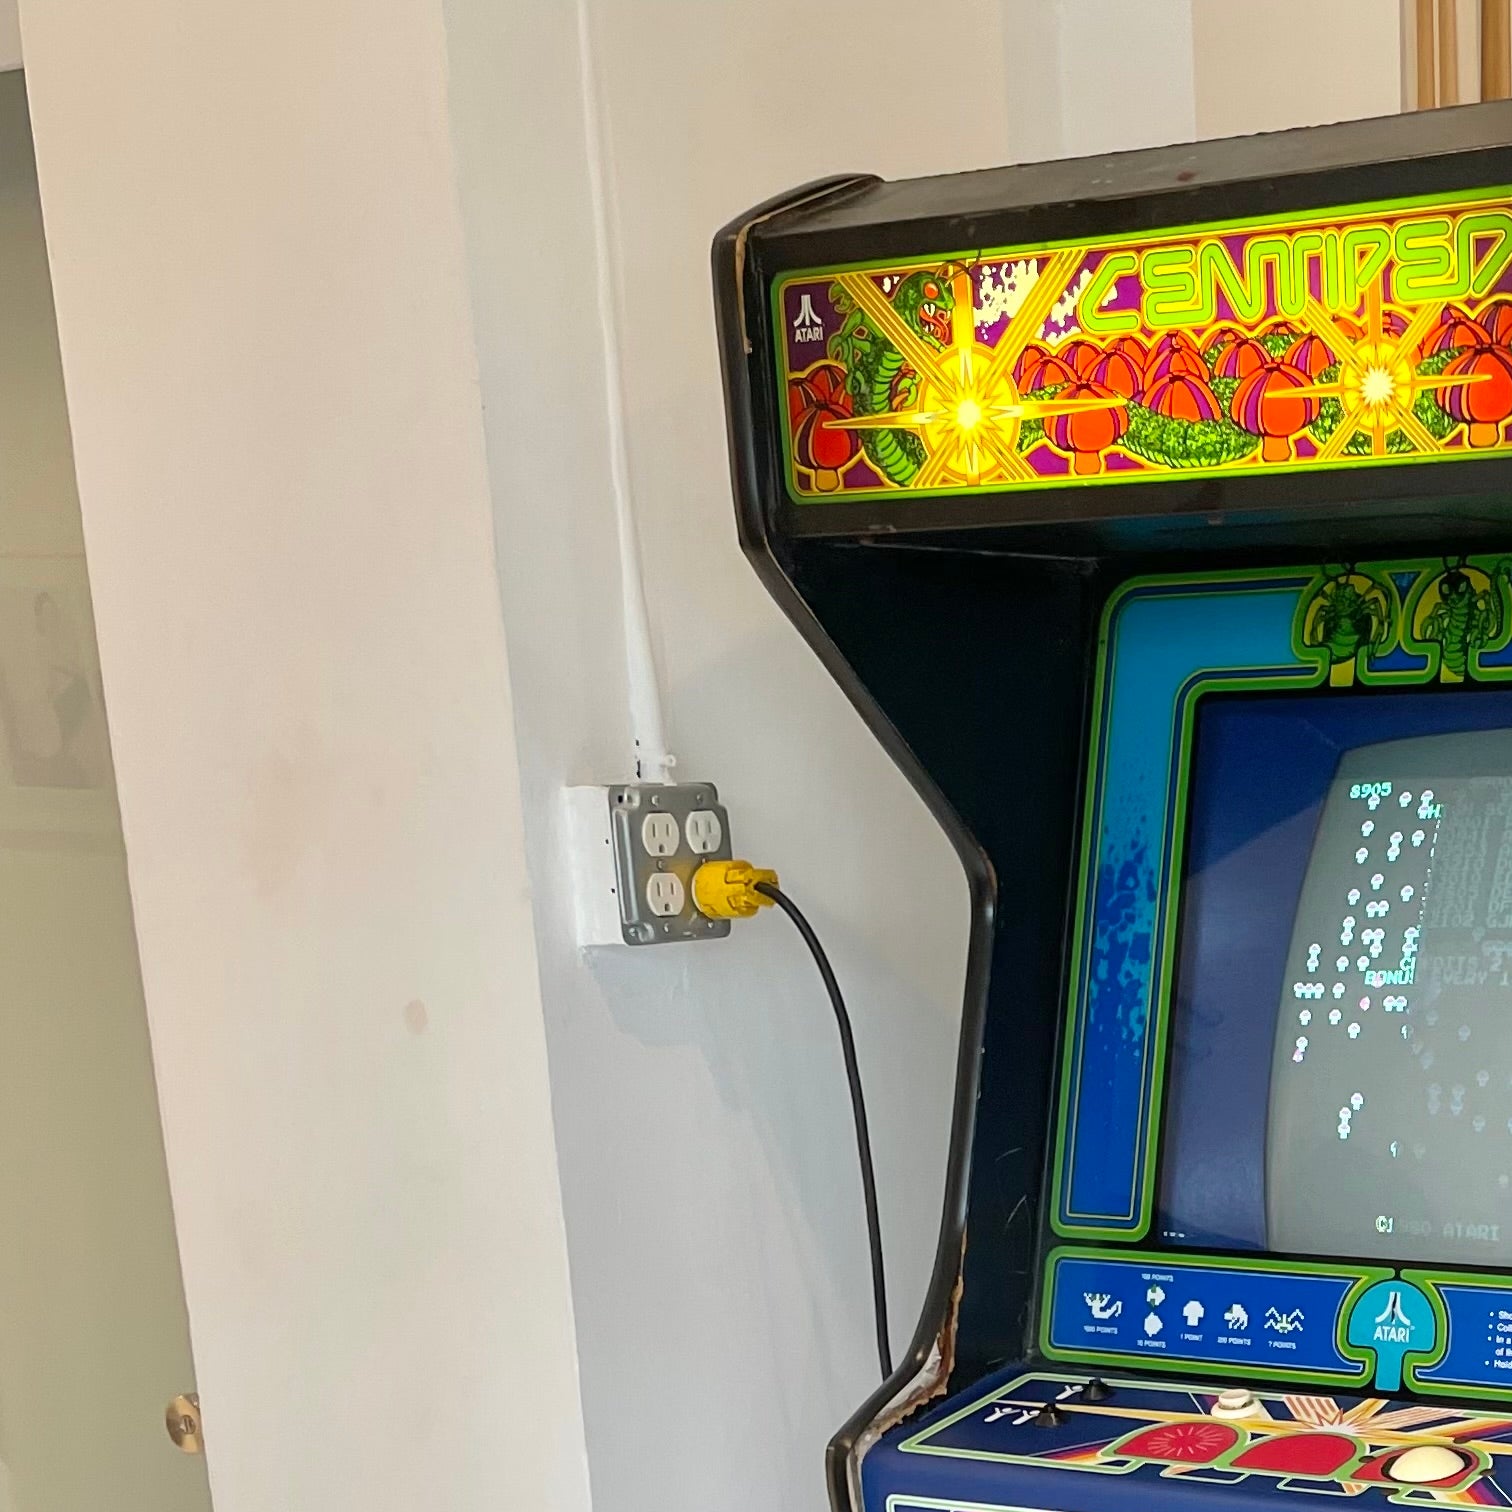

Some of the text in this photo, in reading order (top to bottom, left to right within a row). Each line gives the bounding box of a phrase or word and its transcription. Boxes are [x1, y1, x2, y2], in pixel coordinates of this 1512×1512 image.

[794, 326, 824, 343] ATARI
[1349, 781, 1393, 799] 8905
[1373, 1325, 1410, 1343] ATARI
[1496, 1335, 1505, 1344] In
[1494, 1347, 1505, 1357] of
[1493, 1359, 1512, 1370] Hold
